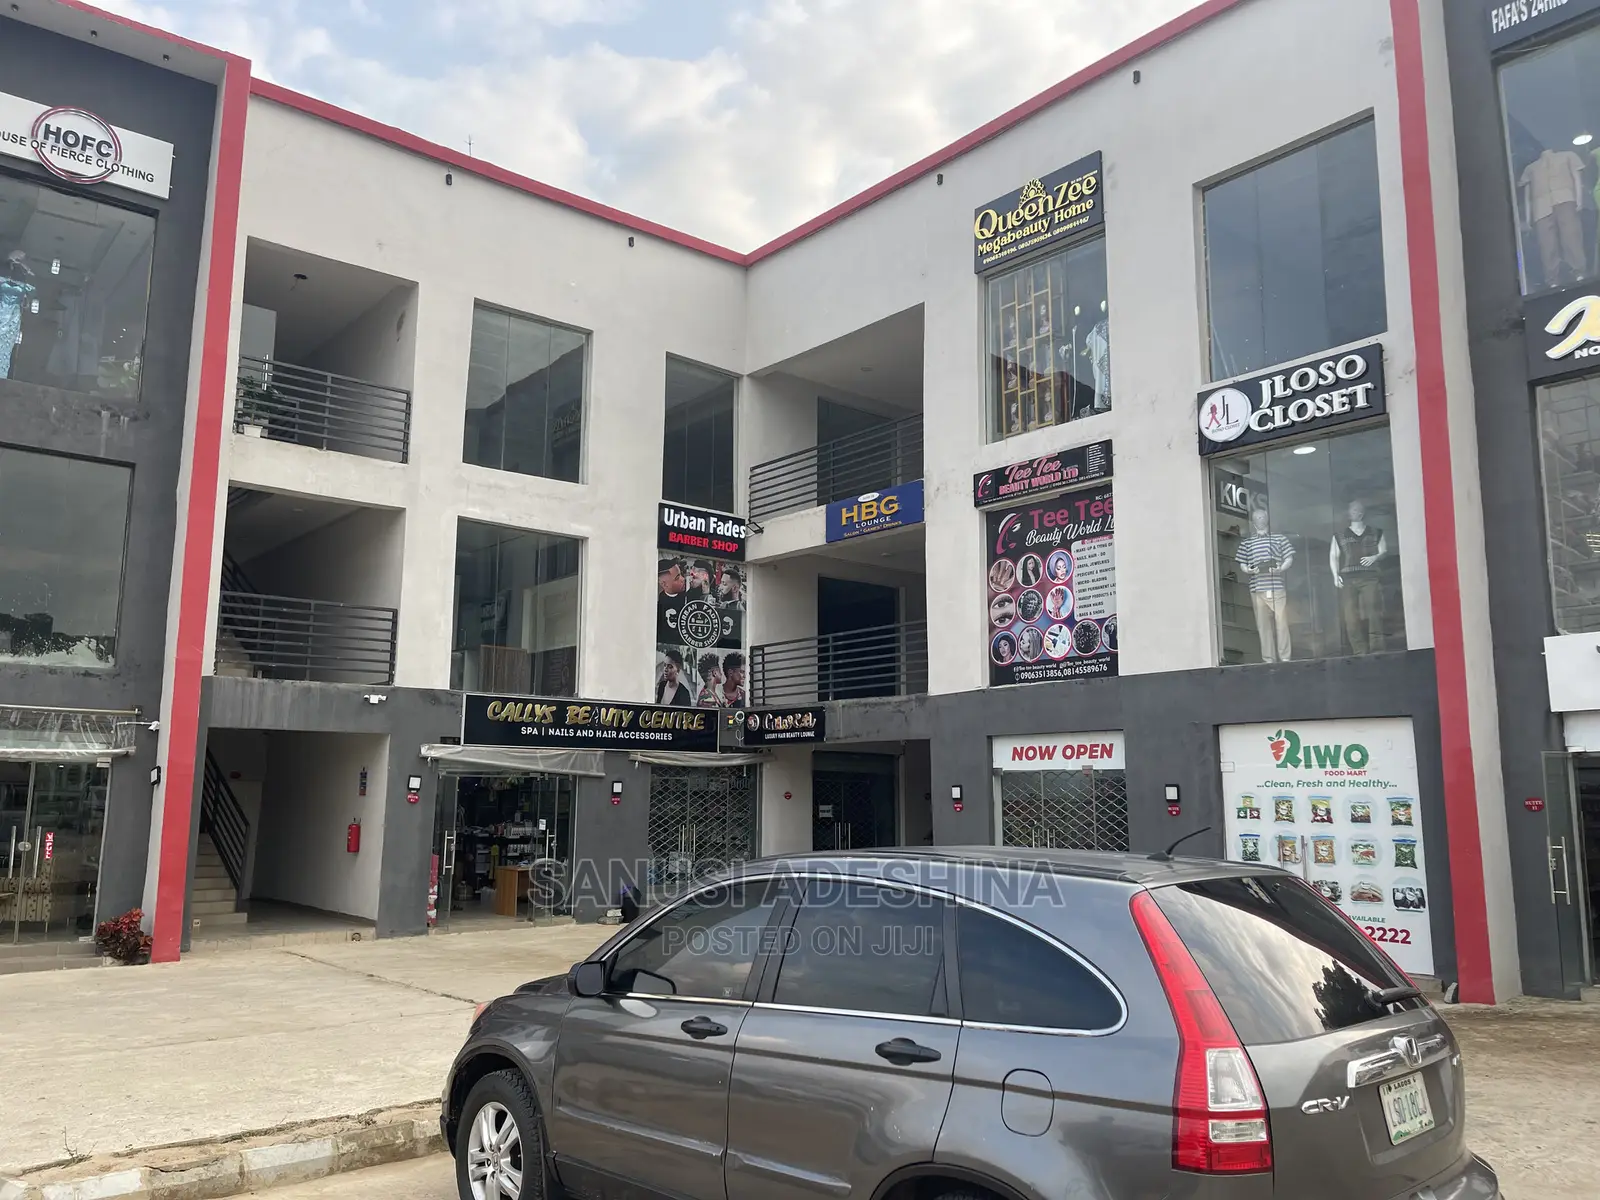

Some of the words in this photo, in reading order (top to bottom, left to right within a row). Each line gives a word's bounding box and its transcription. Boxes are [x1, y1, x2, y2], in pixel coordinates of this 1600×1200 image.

[1491, 0, 1528, 33] FAFA'S
[43, 123, 113, 158] HOFC
[0, 131, 27, 147] OUSE
[31, 140, 47, 151] OF
[50, 145, 93, 165] FIERCE
[96, 158, 155, 183] CLOTHING
[977, 217, 1050, 256] Megabeauty
[1054, 199, 1094, 224] Home
[1259, 354, 1367, 408] JLOSO
[1249, 382, 1375, 432] CLOSET
[999, 480, 1030, 496] BEAUTY
[1031, 471, 1061, 488] WORLD
[1063, 467, 1078, 480] LTD
[1005, 460, 1032, 483] Tee
[1033, 452, 1061, 476] Tee
[664, 508, 706, 532] Urban
[709, 517, 746, 538] Fades
[841, 496, 899, 526] HBG
[855, 516, 891, 529] LOUNGE
[1029, 509, 1069, 529] Tee
[1075, 498, 1114, 521] Tee
[668, 532, 709, 548] BARBER
[712, 540, 739, 553] SHOP
[1025, 527, 1062, 547] Beauty
[1063, 518, 1102, 540] World
[680, 604, 697, 626] URBAN
[487, 700, 556, 724] CALLYS
[566, 705, 635, 729] BEAUTY
[639, 709, 705, 731] CENTRE
[521, 726, 539, 736] SPA
[549, 728, 575, 737] NAILS
[576, 729, 594, 738] AND
[596, 730, 617, 739] HAIR
[618, 731, 673, 741] ACCESSORIES
[1012, 745, 1057, 761] NOW
[1062, 743, 1114, 760] OPEN
[1275, 729, 1369, 769] RIWO
[1296, 779, 1323, 788] Fresh
[1326, 779, 1346, 788] and
